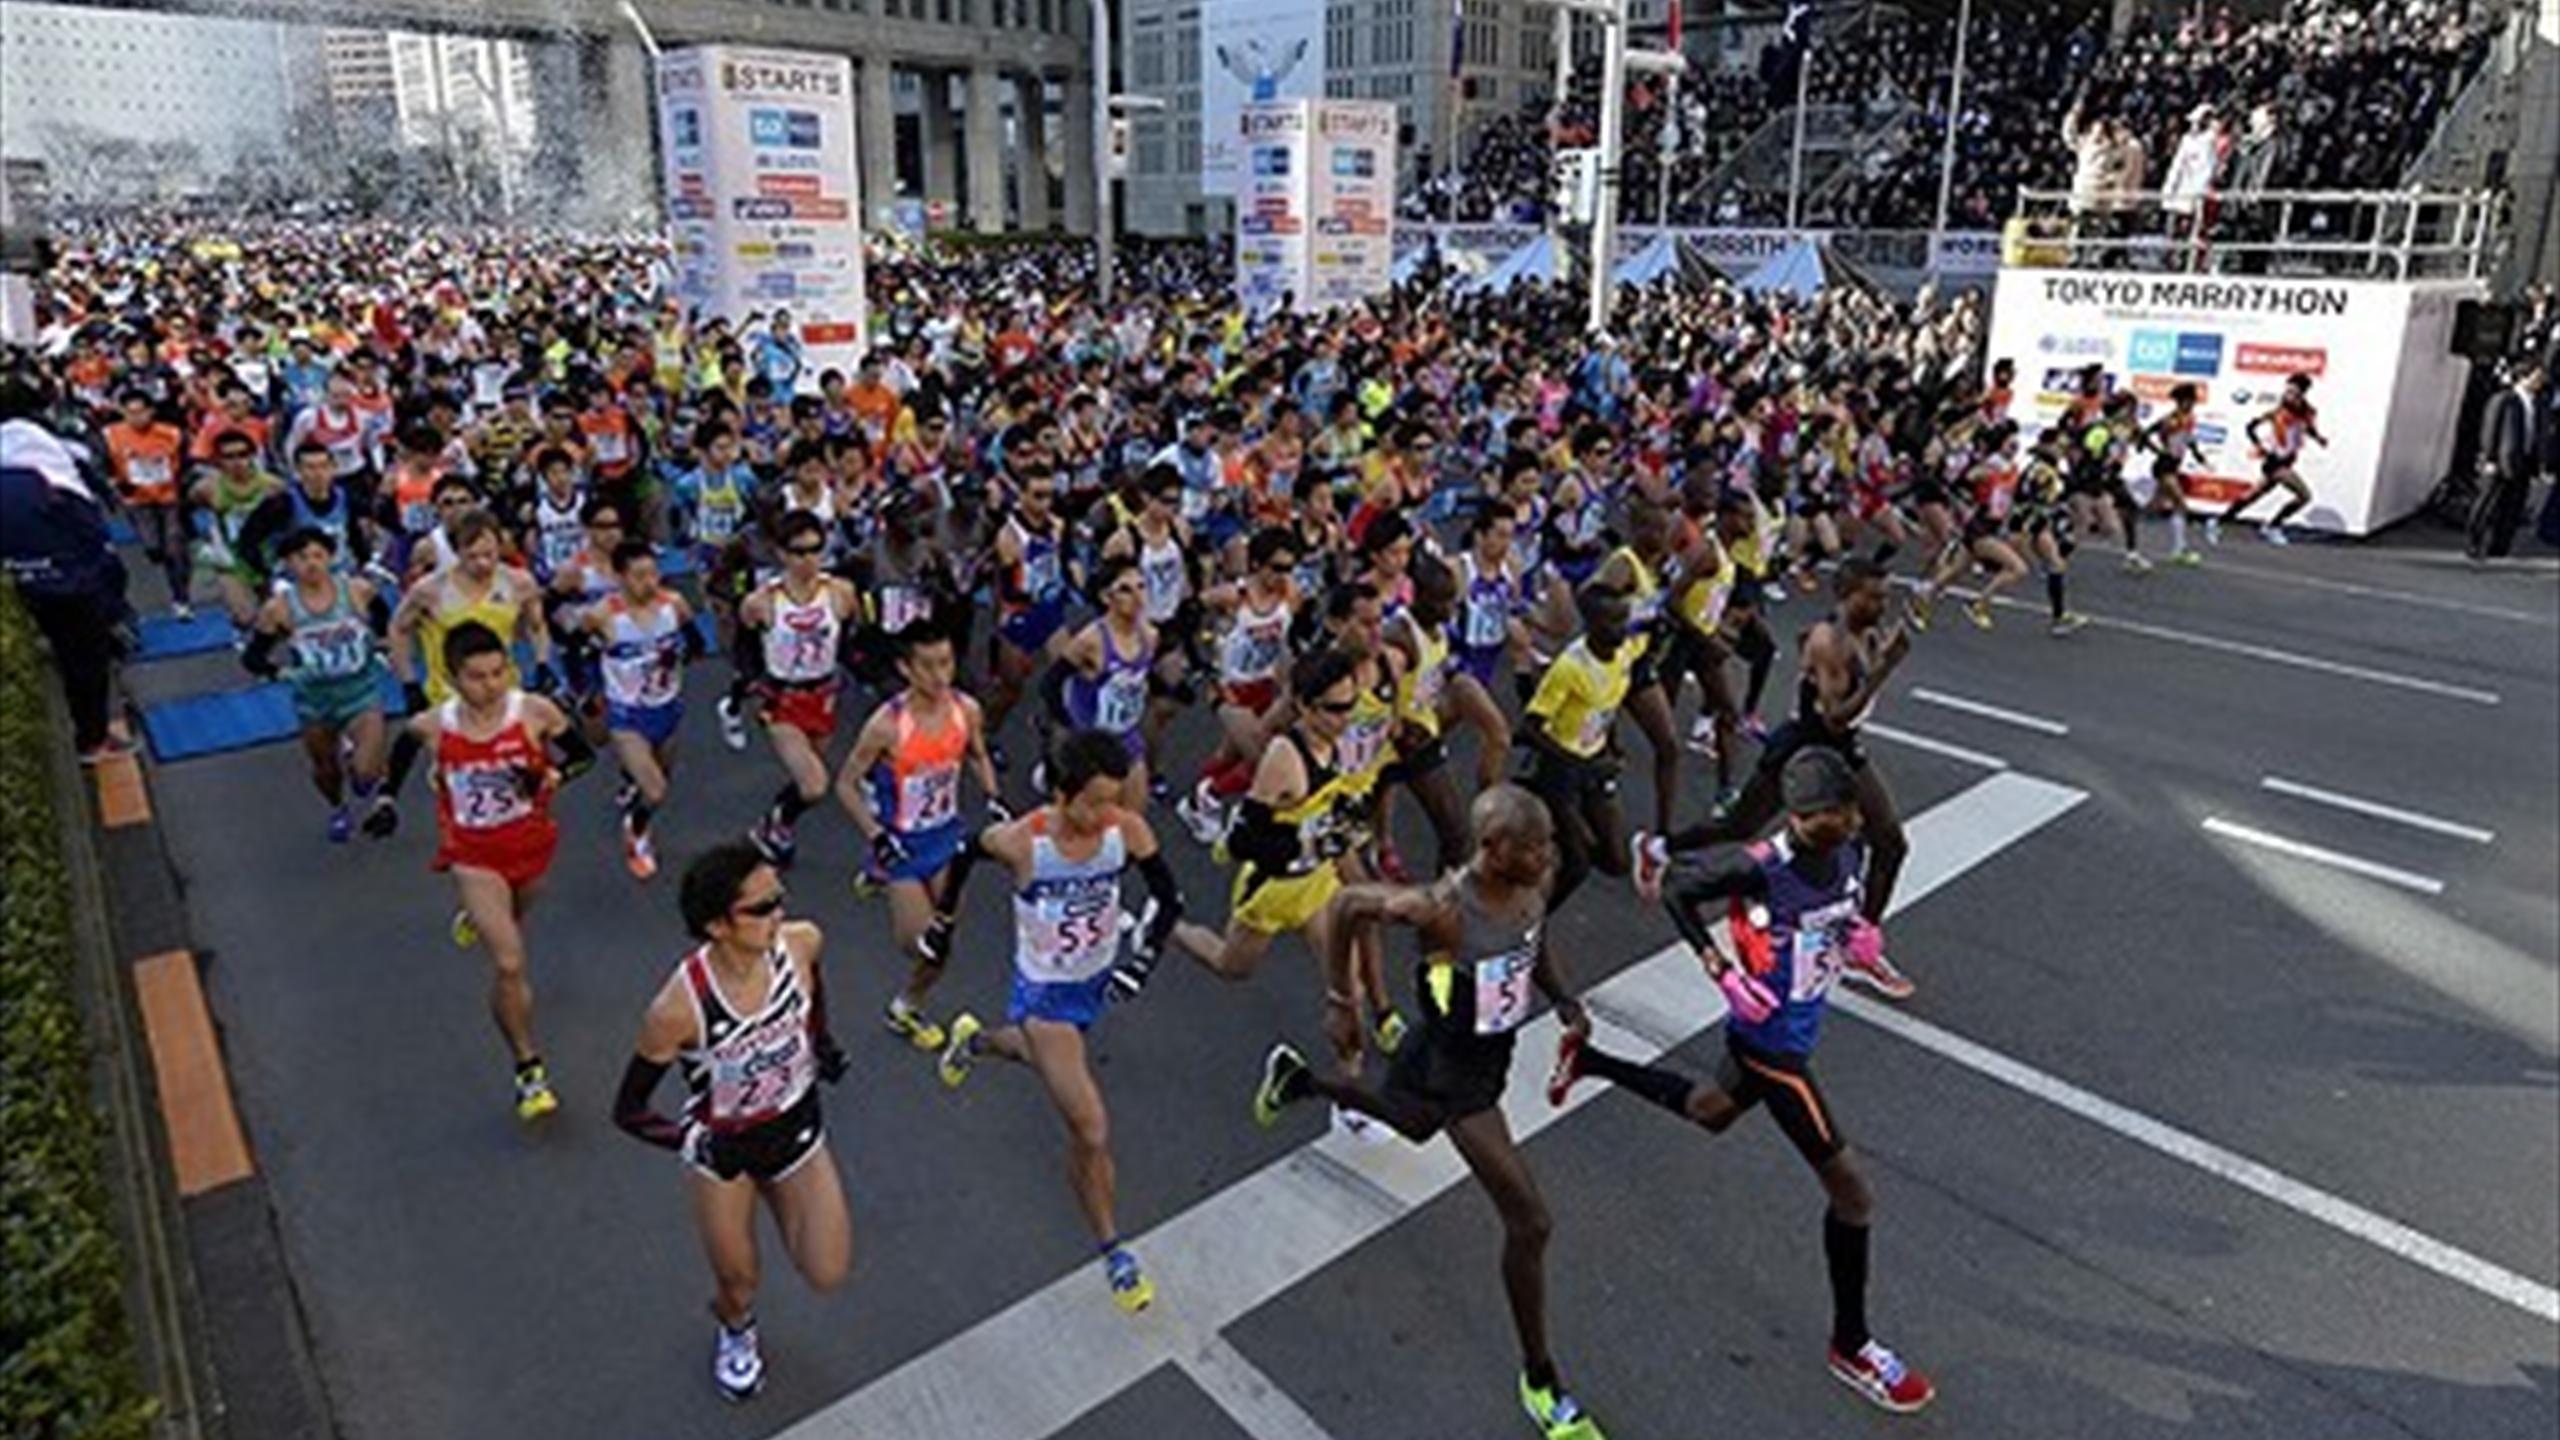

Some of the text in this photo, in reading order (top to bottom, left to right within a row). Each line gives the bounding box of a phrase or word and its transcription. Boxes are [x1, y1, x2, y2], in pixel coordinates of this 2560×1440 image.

[1690, 233, 1799, 257] MARATH
[2043, 277, 2349, 315] TOKYO MARATHON
[466, 787, 513, 817] 25
[1058, 917, 1102, 953] 55
